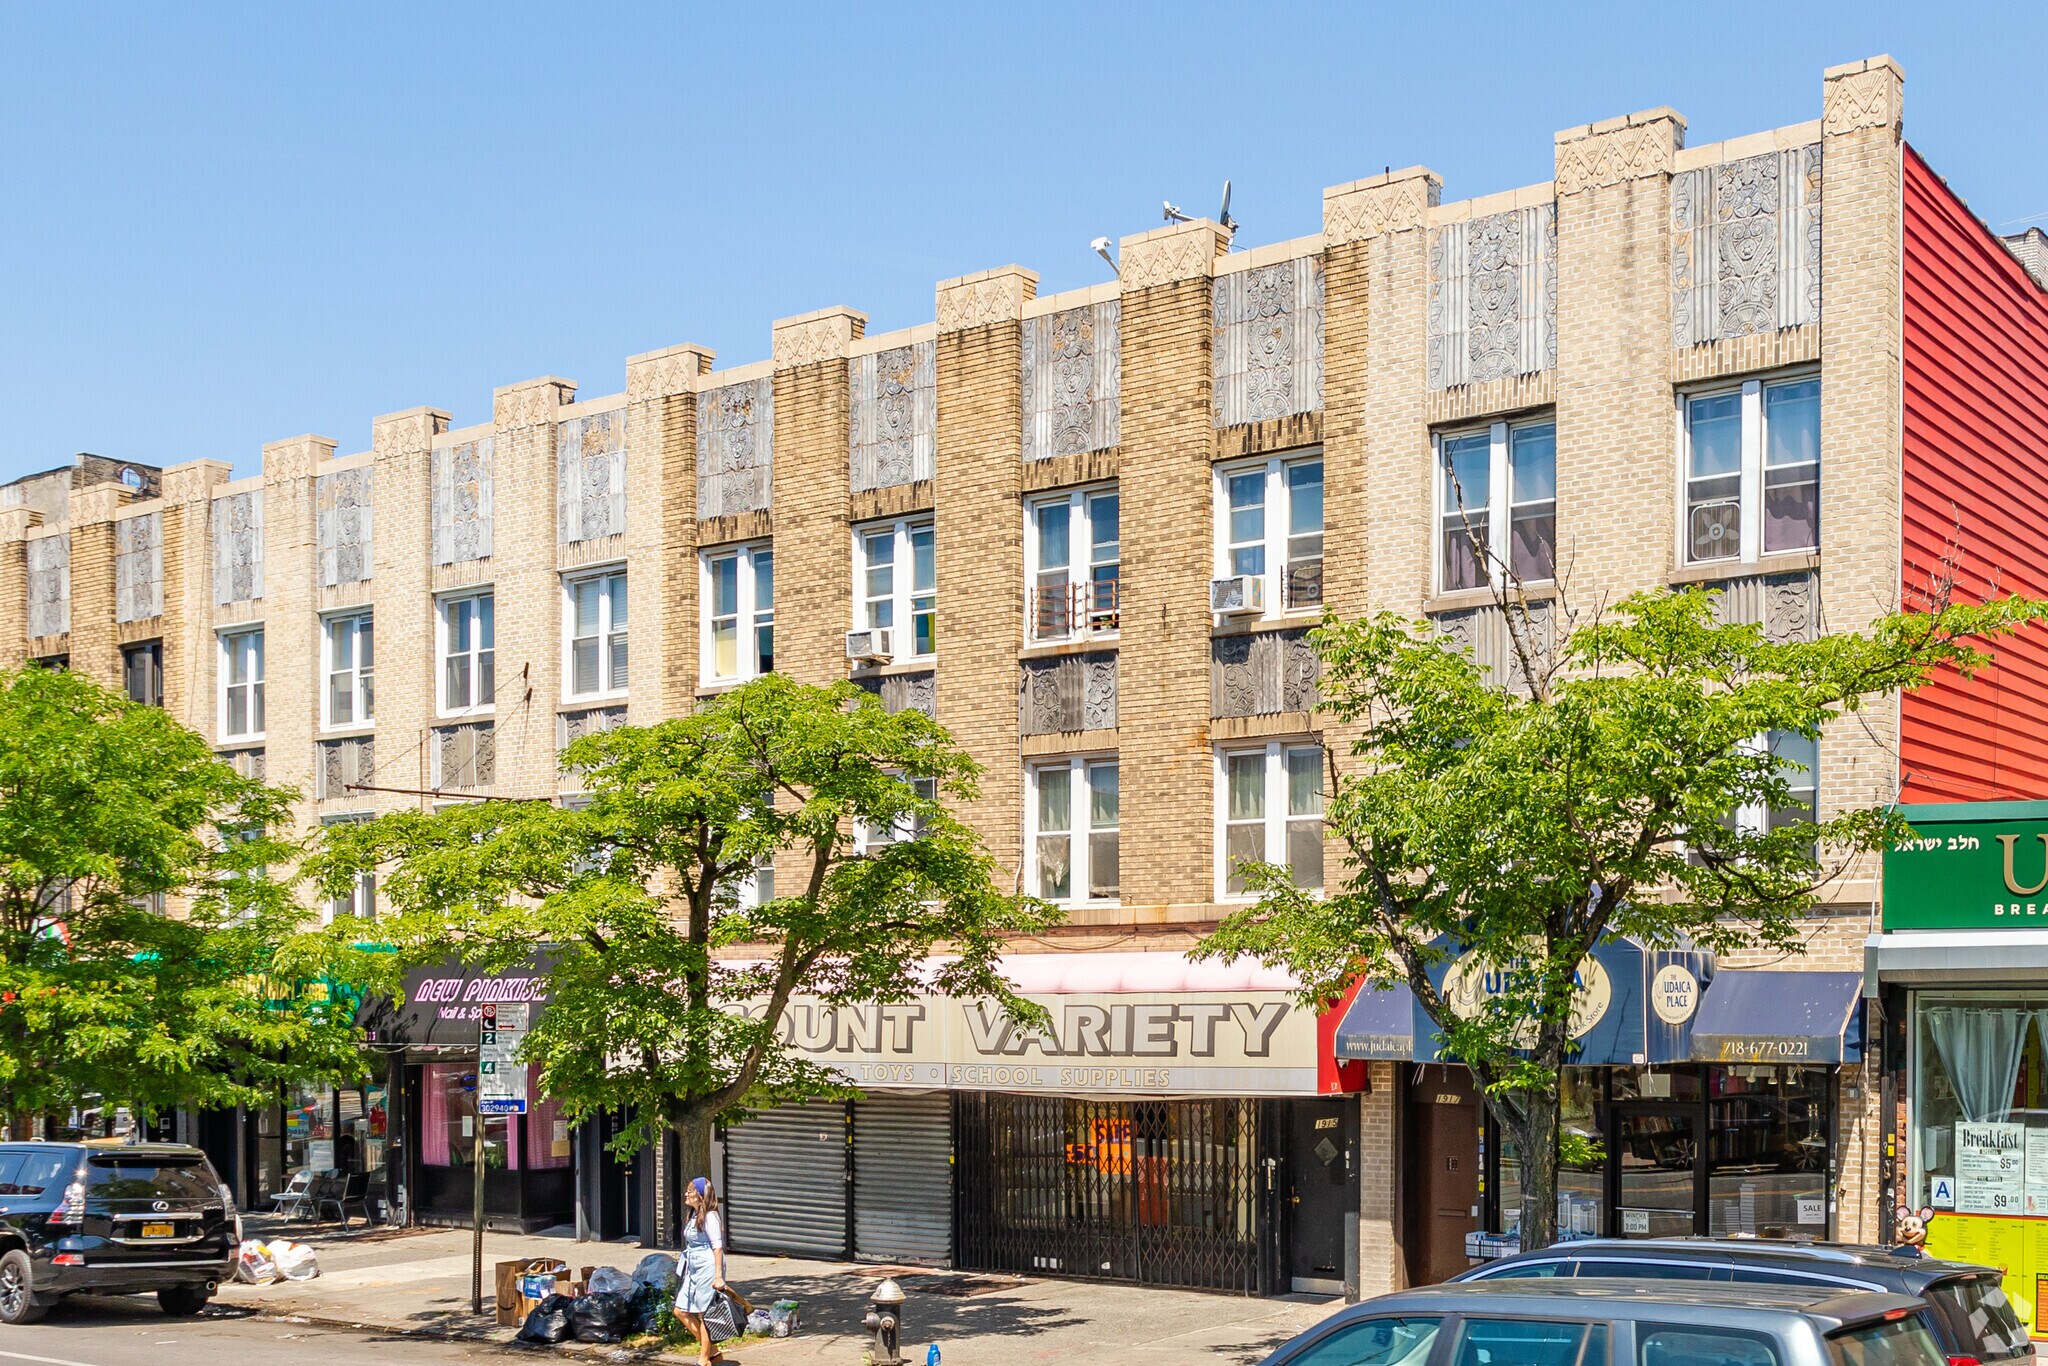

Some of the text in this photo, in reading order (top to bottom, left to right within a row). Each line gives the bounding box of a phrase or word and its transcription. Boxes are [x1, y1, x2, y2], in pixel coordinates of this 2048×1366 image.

[1947, 835, 1980, 850] חלב
[414, 979, 463, 1002] NEW
[1666, 995, 1688, 1007] PLACE
[437, 1006, 482, 1021] Nail & Sp
[1586, 1002, 1604, 1024] Store
[963, 1002, 1292, 1057] VARIETY
[485, 1033, 493, 1044] 2
[1723, 1041, 1808, 1056] 718-677-0221
[484, 1063, 493, 1073] 4
[860, 1064, 915, 1081] TOYS
[952, 1066, 1171, 1088] SCHOOL SUPPLIES
[1437, 1094, 1461, 1104] 1917
[1317, 1118, 1339, 1129] 1915
[1962, 1128, 2019, 1149] Breakfast
[1935, 1181, 1950, 1199] A
[1803, 1204, 1821, 1212] SALE
[1638, 1223, 1647, 1231] PM
